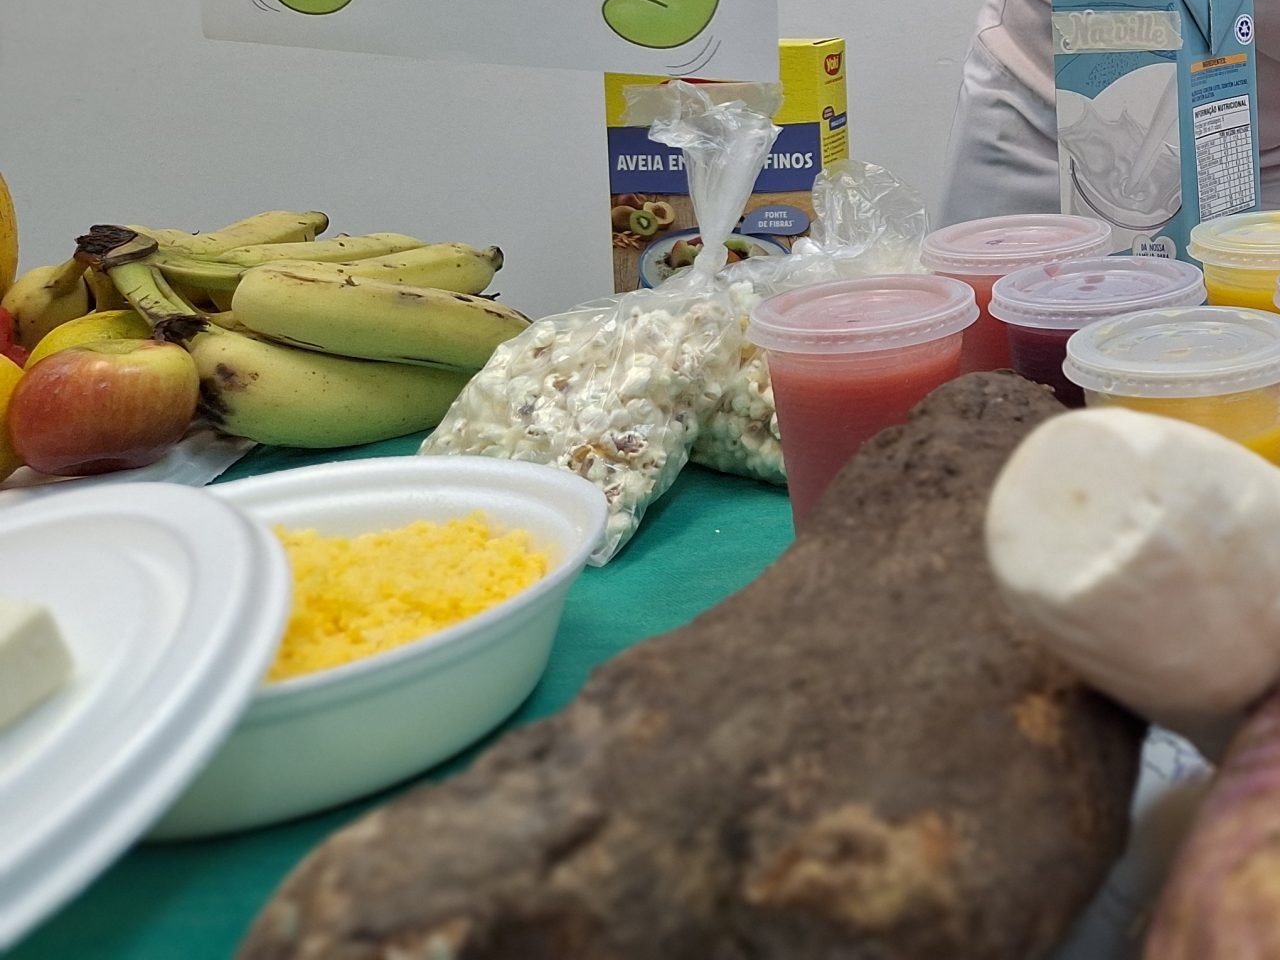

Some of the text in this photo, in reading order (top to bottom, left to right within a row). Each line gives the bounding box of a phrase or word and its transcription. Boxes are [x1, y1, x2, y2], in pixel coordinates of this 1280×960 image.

[616, 154, 664, 171] AVEIA
[763, 152, 814, 169] FINOS
[765, 211, 787, 219] FONTE
